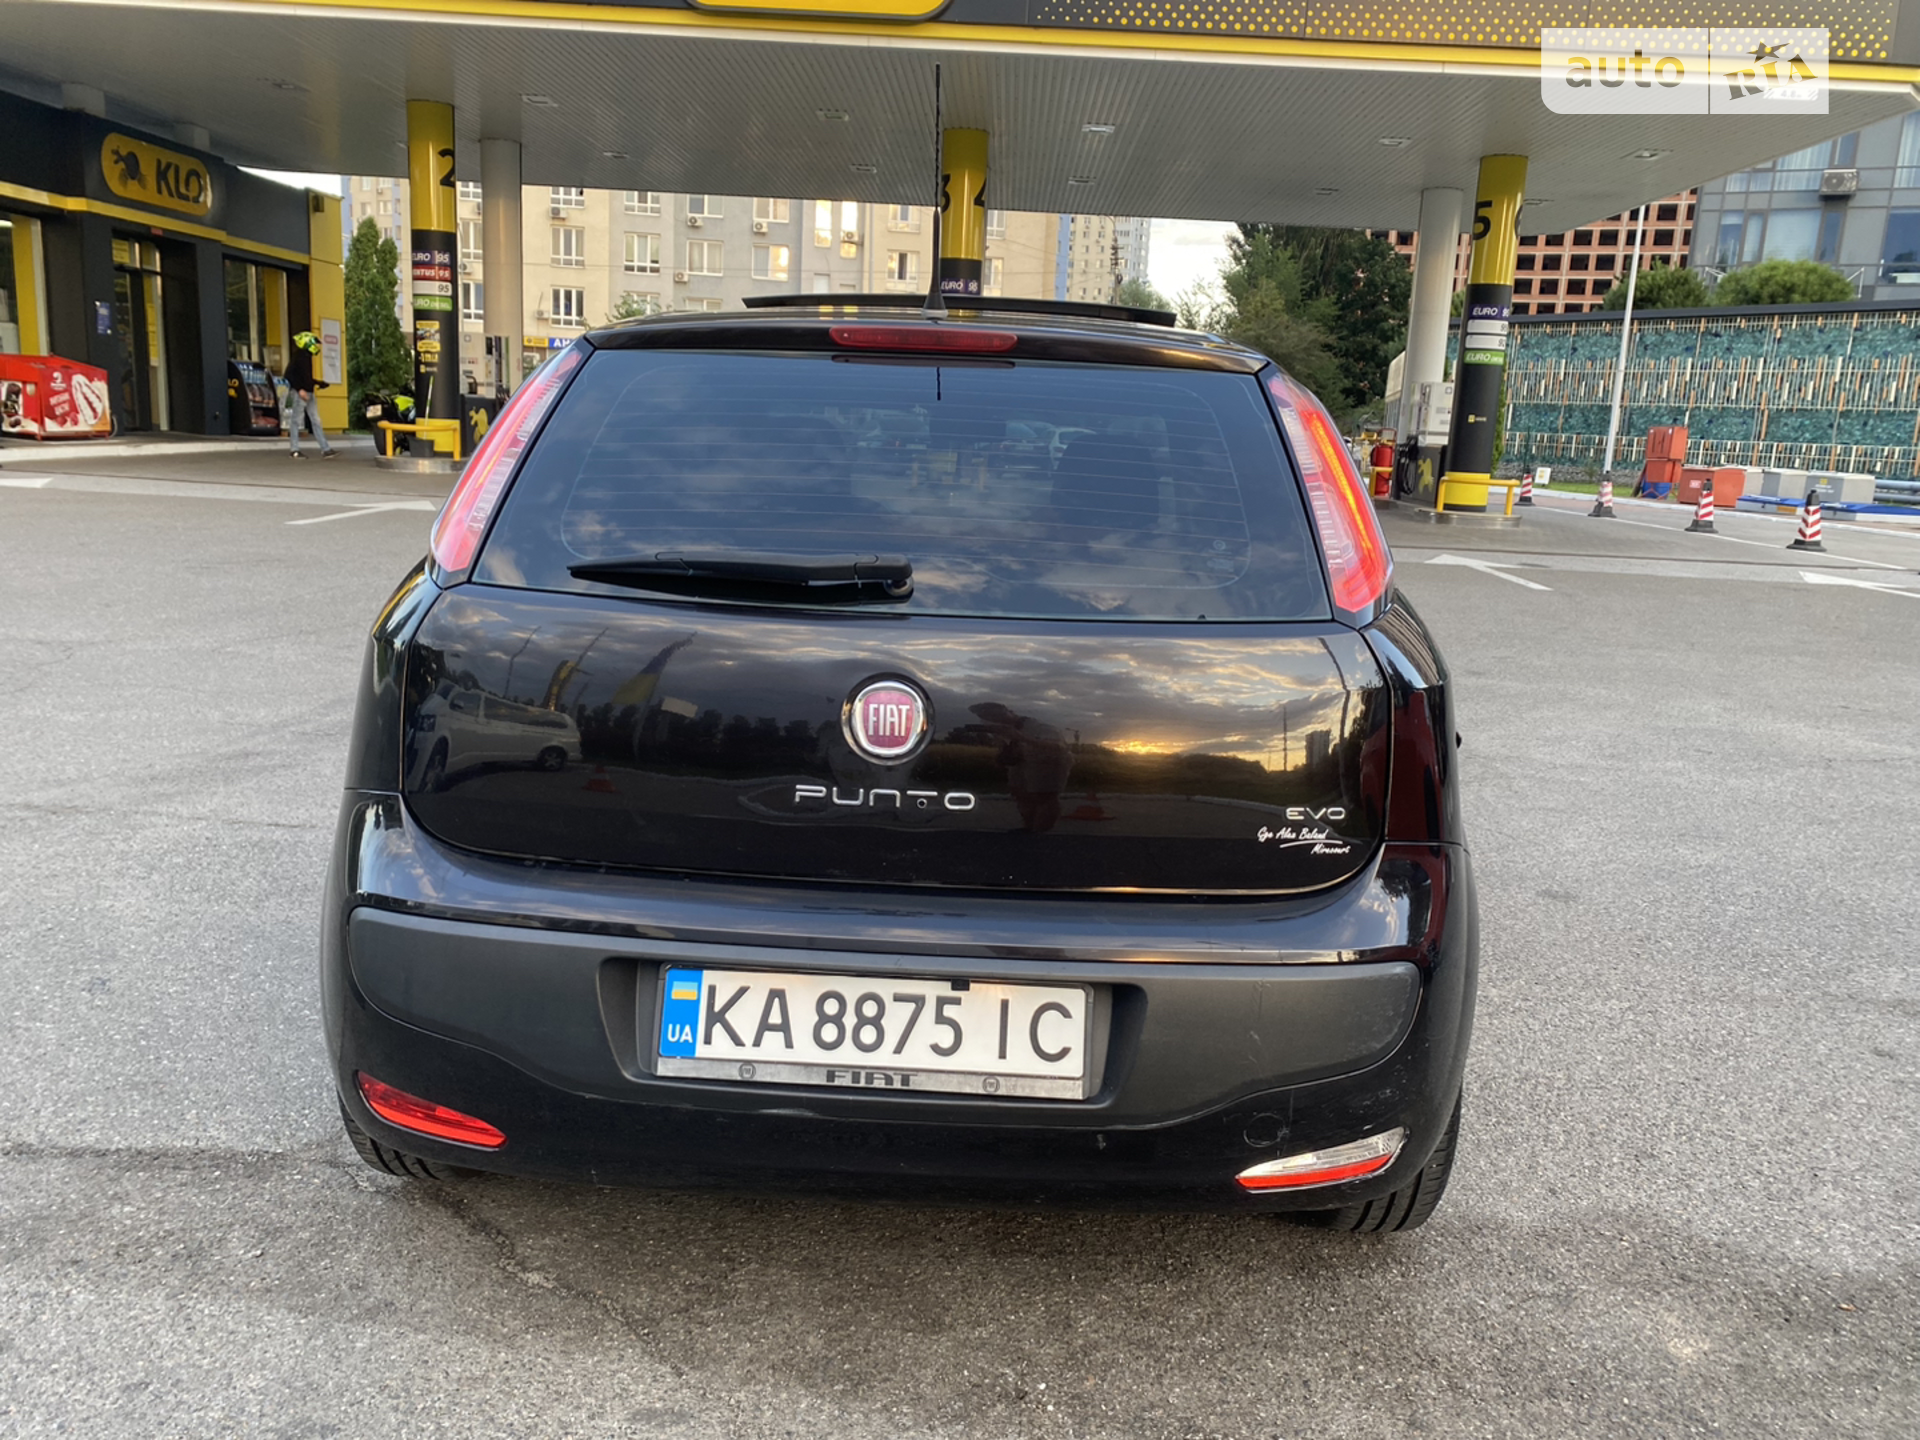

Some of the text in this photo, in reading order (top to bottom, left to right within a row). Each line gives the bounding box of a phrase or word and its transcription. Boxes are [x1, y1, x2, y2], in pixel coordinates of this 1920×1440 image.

[437, 148, 456, 188] 2
[156, 158, 203, 204] KLO
[1472, 200, 1493, 241] 5
[438, 283, 450, 293] 95
[1472, 306, 1498, 317] EURO
[1466, 352, 1491, 363] EURO
[868, 703, 910, 737] FIAT
[794, 784, 976, 811] PUNTO
[1286, 807, 1346, 820] EVO
[667, 1023, 694, 1043] UA
[703, 984, 1073, 1063] KA 8875 IC
[826, 1069, 918, 1087] FIAT
